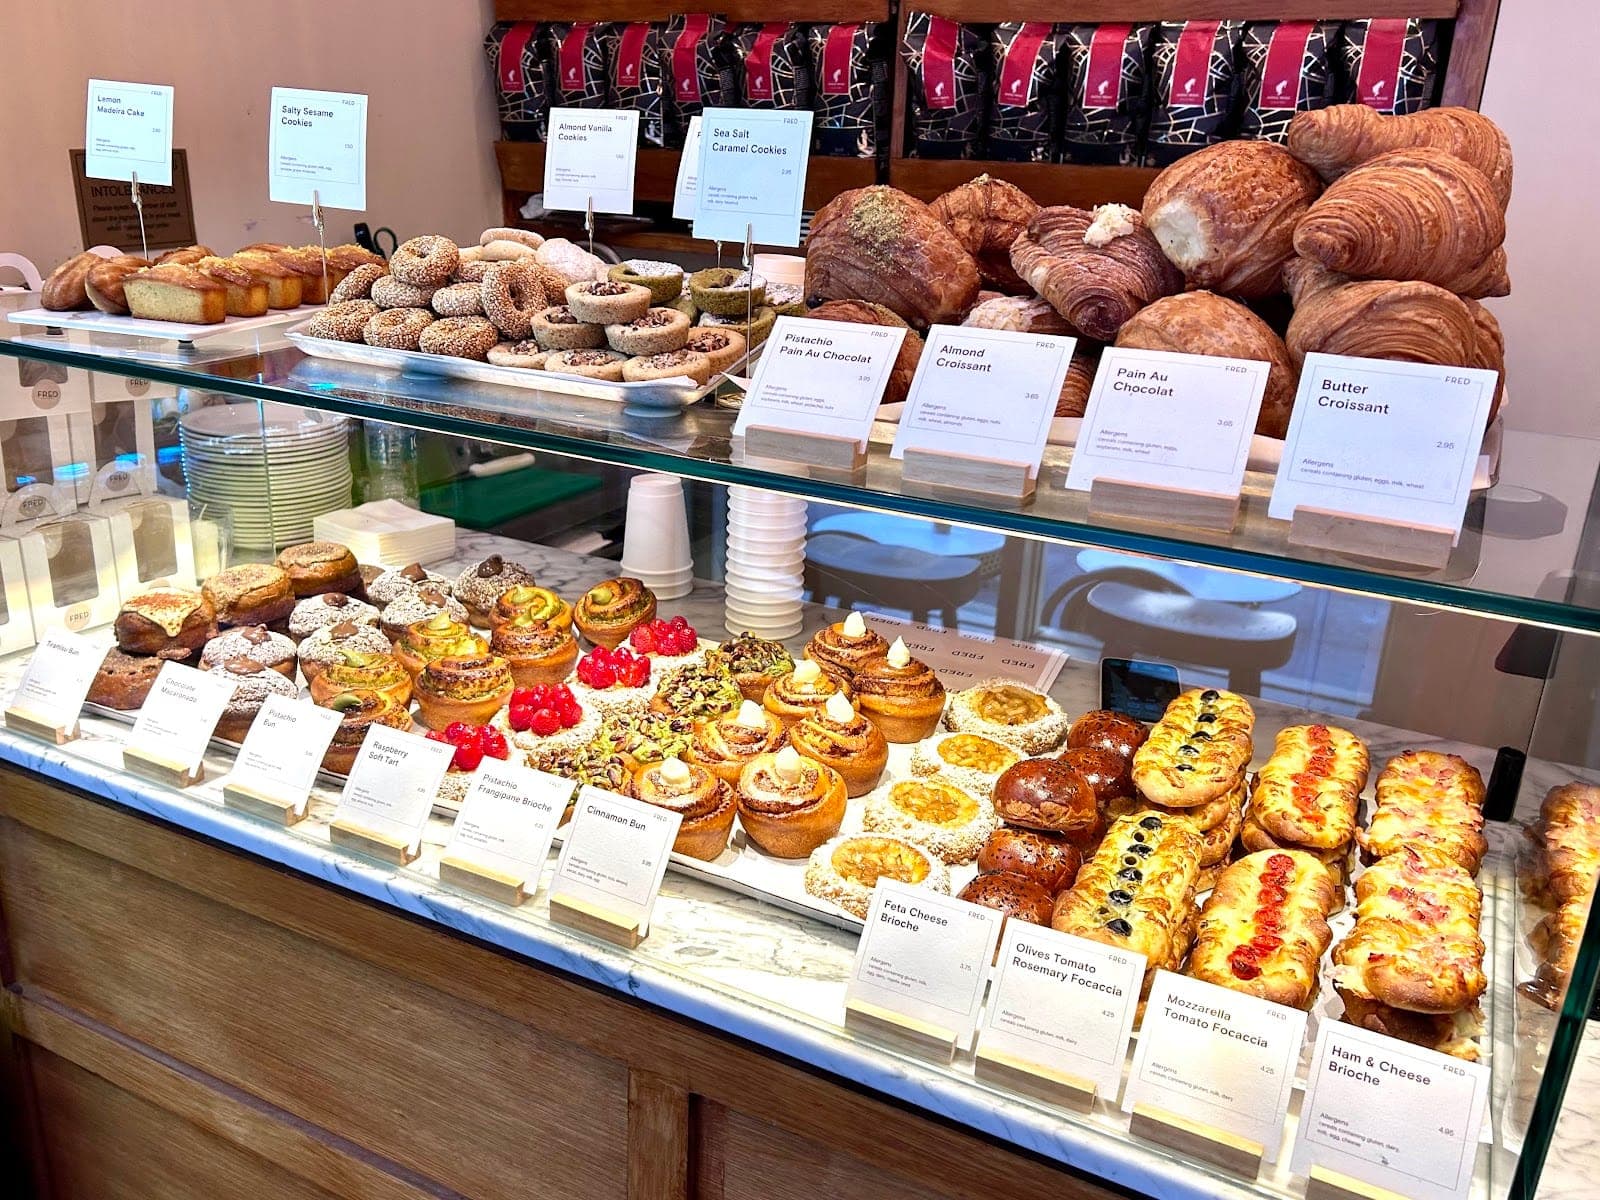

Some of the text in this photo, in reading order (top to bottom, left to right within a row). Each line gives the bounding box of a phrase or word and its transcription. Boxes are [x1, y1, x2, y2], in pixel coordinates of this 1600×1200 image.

[97, 95, 121, 104] Lemon
[97, 105, 145, 117] Madeira Cake
[282, 105, 334, 118] Salty Sesame
[281, 117, 313, 127] Cookies
[559, 123, 612, 132] Almond Vanilla
[558, 133, 587, 141] Cookies
[713, 128, 730, 138] Sea
[732, 129, 749, 139] Salt
[712, 142, 787, 155] Caramel Cookies
[91, 186, 176, 197] INTOLEANCES
[784, 333, 833, 346] Pistachio
[1036, 341, 1056, 349] FRED
[779, 346, 871, 364] Pain Au Chocolat
[940, 344, 985, 358] Almond
[936, 357, 992, 373] Croissant
[1225, 365, 1247, 374] FRED
[1117, 367, 1168, 382] Pain Au
[1445, 375, 1471, 385] FRED
[1113, 381, 1174, 397] Chocolat
[1322, 379, 1368, 395] Butter
[37, 390, 59, 398] FRED
[1318, 396, 1390, 415] Croissant
[1100, 429, 1128, 437] Allergens
[1436, 441, 1455, 450] 2.95
[1302, 458, 1334, 468] Allergens
[109, 473, 128, 481] FRED
[22, 500, 44, 508] FRED
[69, 611, 89, 623] FRED
[870, 617, 901, 626] FRED
[68, 647, 80, 656] Bun
[905, 642, 935, 652] FRED
[951, 649, 985, 660] FRED
[1001, 658, 1035, 669] FRED
[938, 668, 973, 678] FRED
[166, 677, 196, 692] Chocolate
[269, 709, 297, 723] Pistachio
[263, 719, 276, 728] Bun
[373, 741, 408, 759] Raspberry
[369, 751, 399, 767] Soft Tart
[482, 773, 518, 790] Pistachio
[478, 784, 552, 813] Frangipane Brioche
[586, 805, 647, 831] Cinnamon Bun
[884, 899, 948, 927] Feta Cheese
[968, 910, 986, 921] FRED
[880, 912, 920, 933] Brioche
[1016, 942, 1097, 974] Olives Tomato
[1108, 954, 1127, 965] FRED
[1012, 956, 1123, 997] Rosemary Focaccia
[1167, 993, 1232, 1021] Mozzarella
[1001, 1009, 1026, 1021] Allergens
[1101, 1009, 1115, 1019] 4.25
[1266, 1009, 1287, 1021] FRED
[1164, 1006, 1269, 1049] Tomato Focaccia
[1151, 1061, 1178, 1075] Allergens
[1260, 1065, 1275, 1076] 4.25
[1332, 1045, 1432, 1086] Ham & Cheese
[1442, 1064, 1466, 1077] FRED
[1328, 1061, 1381, 1086] Brioche
[1320, 1112, 1349, 1127] Allergens
[1438, 1126, 1455, 1137] 4.95
